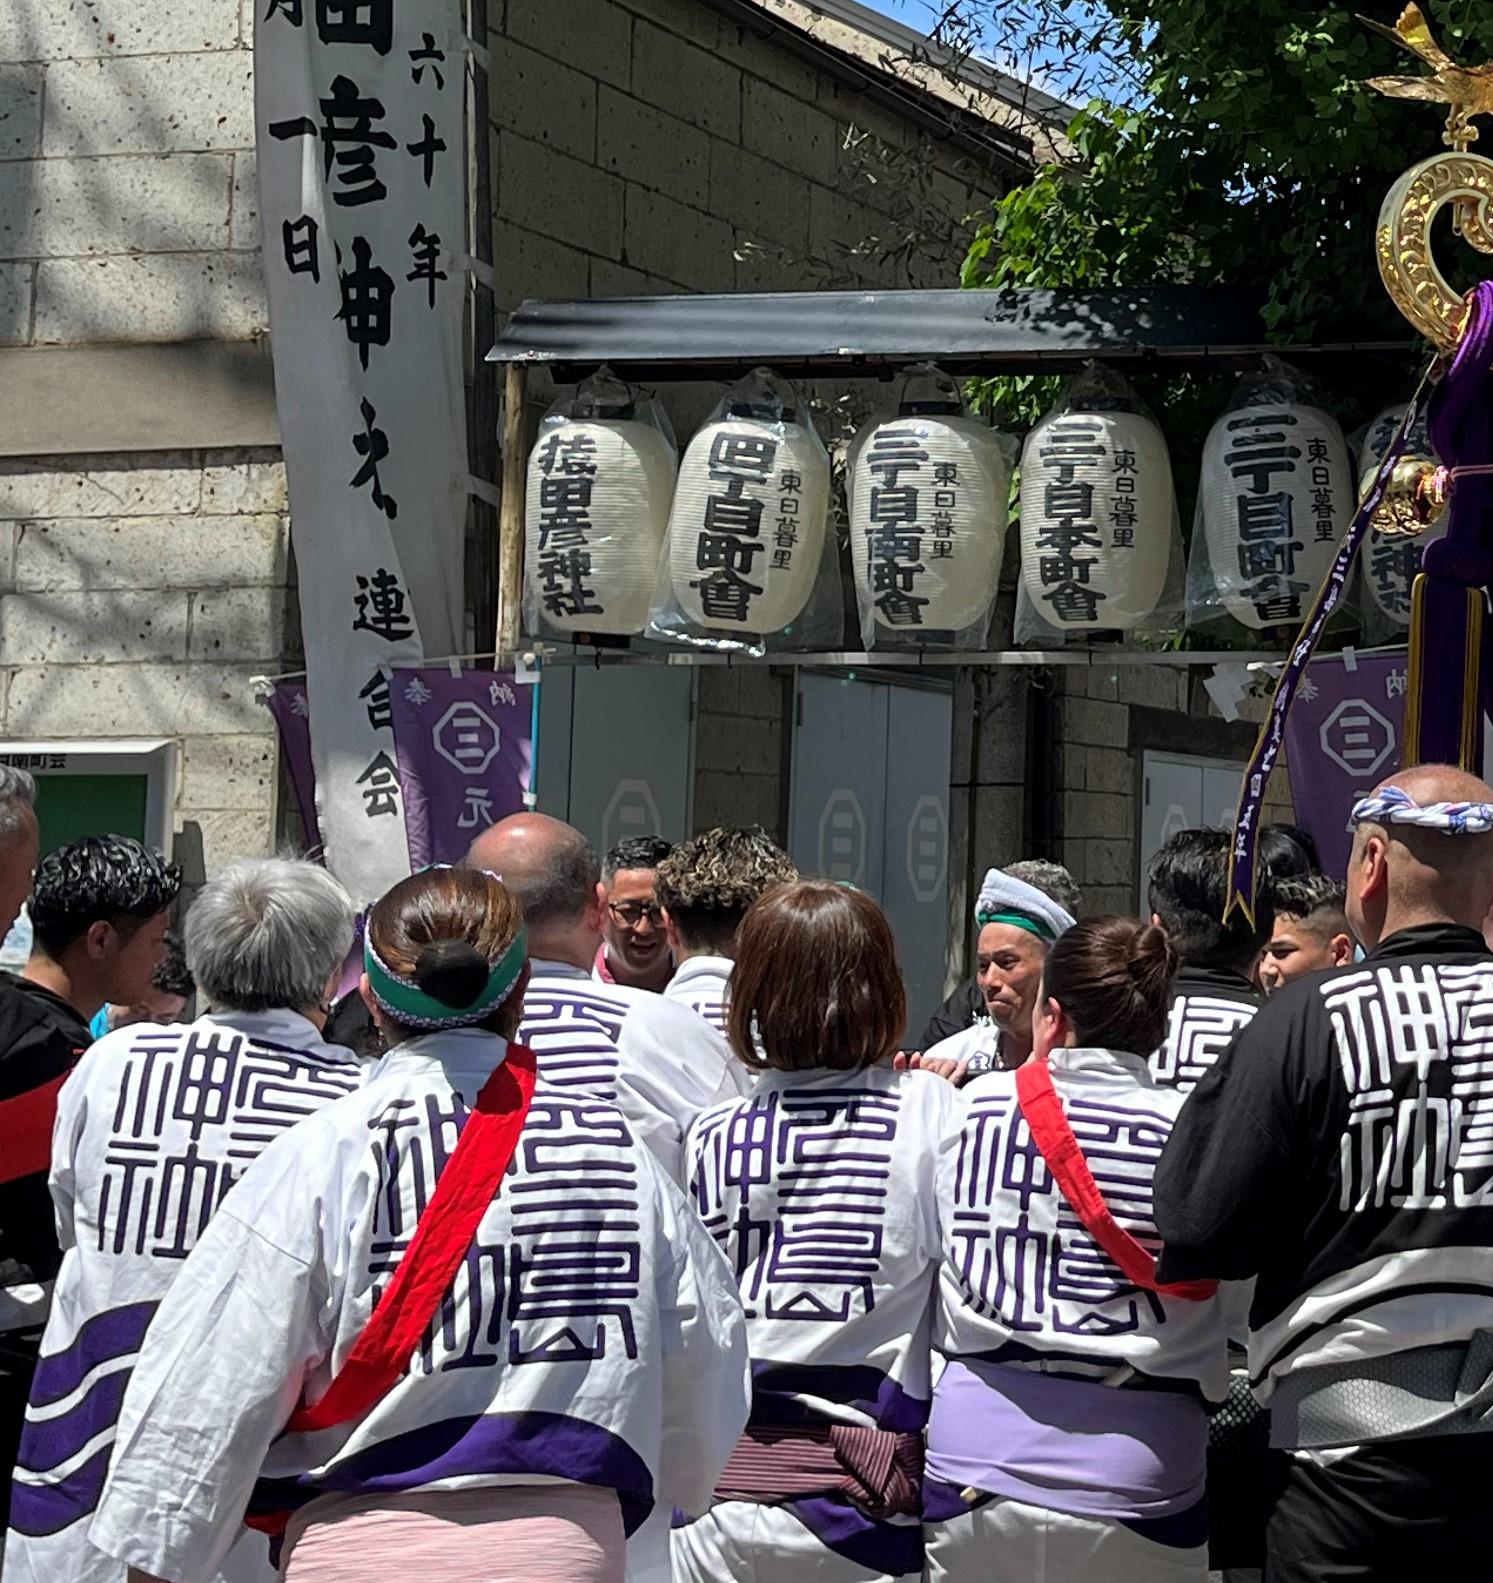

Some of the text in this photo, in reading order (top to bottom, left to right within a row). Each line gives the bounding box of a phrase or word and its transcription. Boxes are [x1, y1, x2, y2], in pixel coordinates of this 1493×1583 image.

[538, 434, 603, 617] 猿田彦神社
[690, 432, 777, 622] 四丁目町會
[769, 468, 802, 571] 東日暮里
[929, 461, 961, 560] 東日暮里
[1034, 423, 1107, 622] 三丁目本町會
[1108, 449, 1139, 548] 東日暮里
[1305, 436, 1337, 543] 東日暮里
